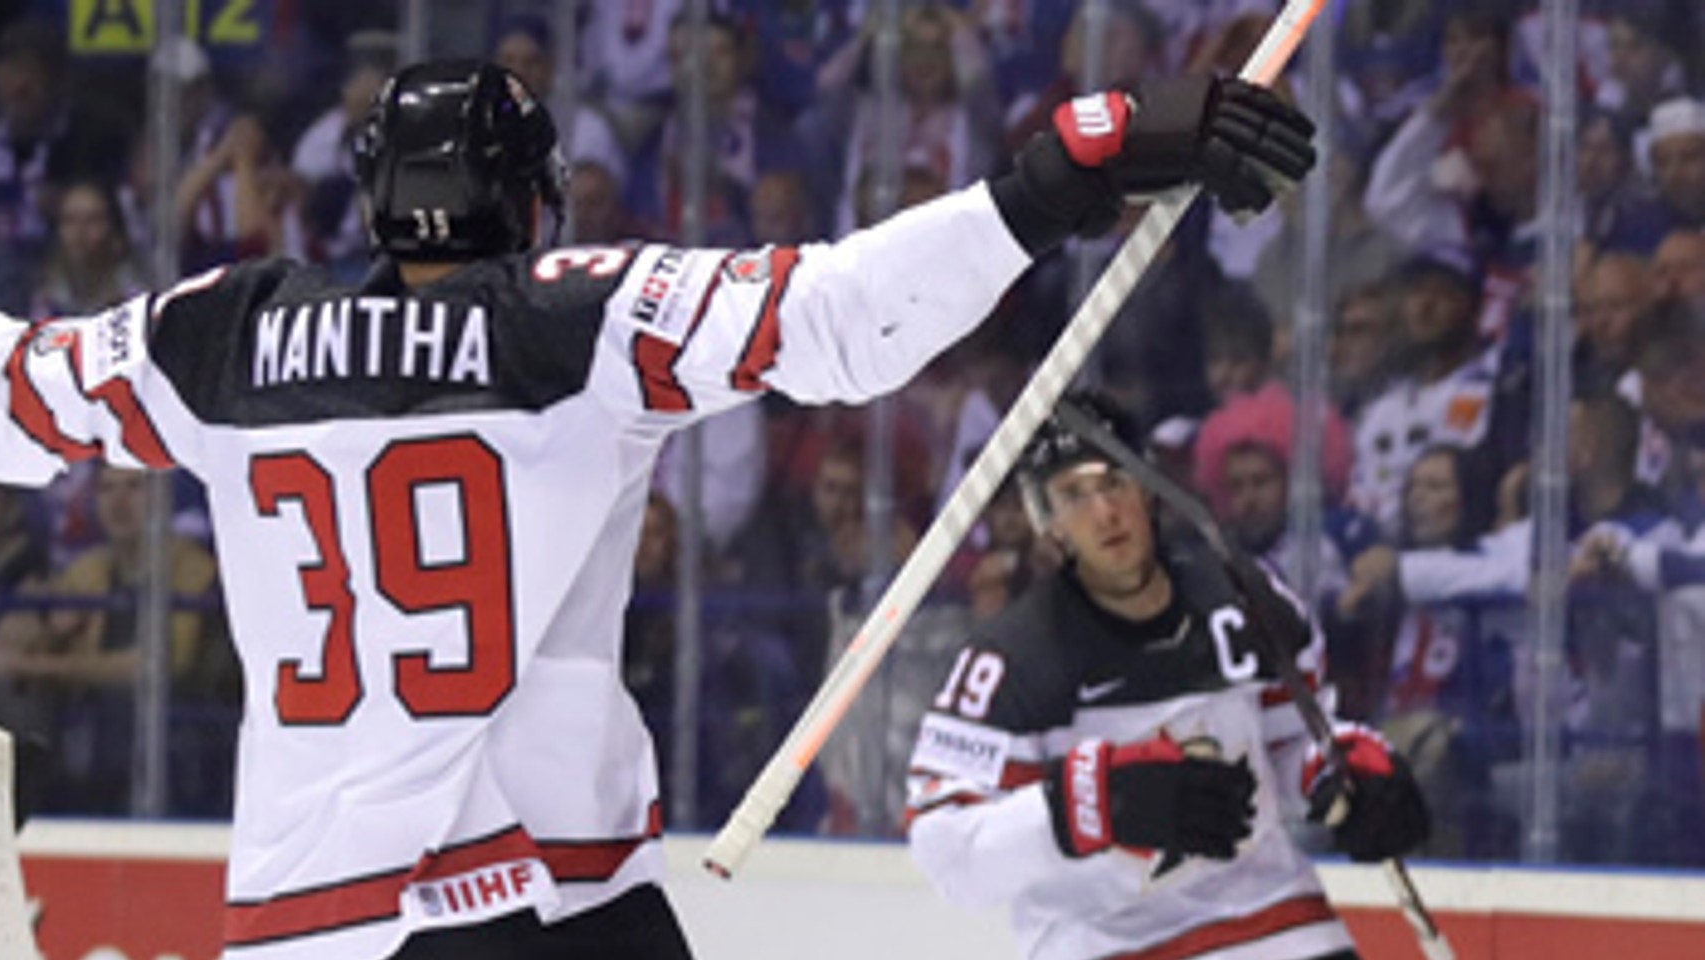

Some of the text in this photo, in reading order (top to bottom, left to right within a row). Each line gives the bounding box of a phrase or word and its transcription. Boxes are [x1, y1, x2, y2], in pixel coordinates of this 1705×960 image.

[253, 297, 492, 388] MANTHA
[247, 428, 518, 728] 39
[1208, 604, 1258, 680] C
[934, 647, 1006, 718] 19
[444, 864, 533, 913] IIHF
